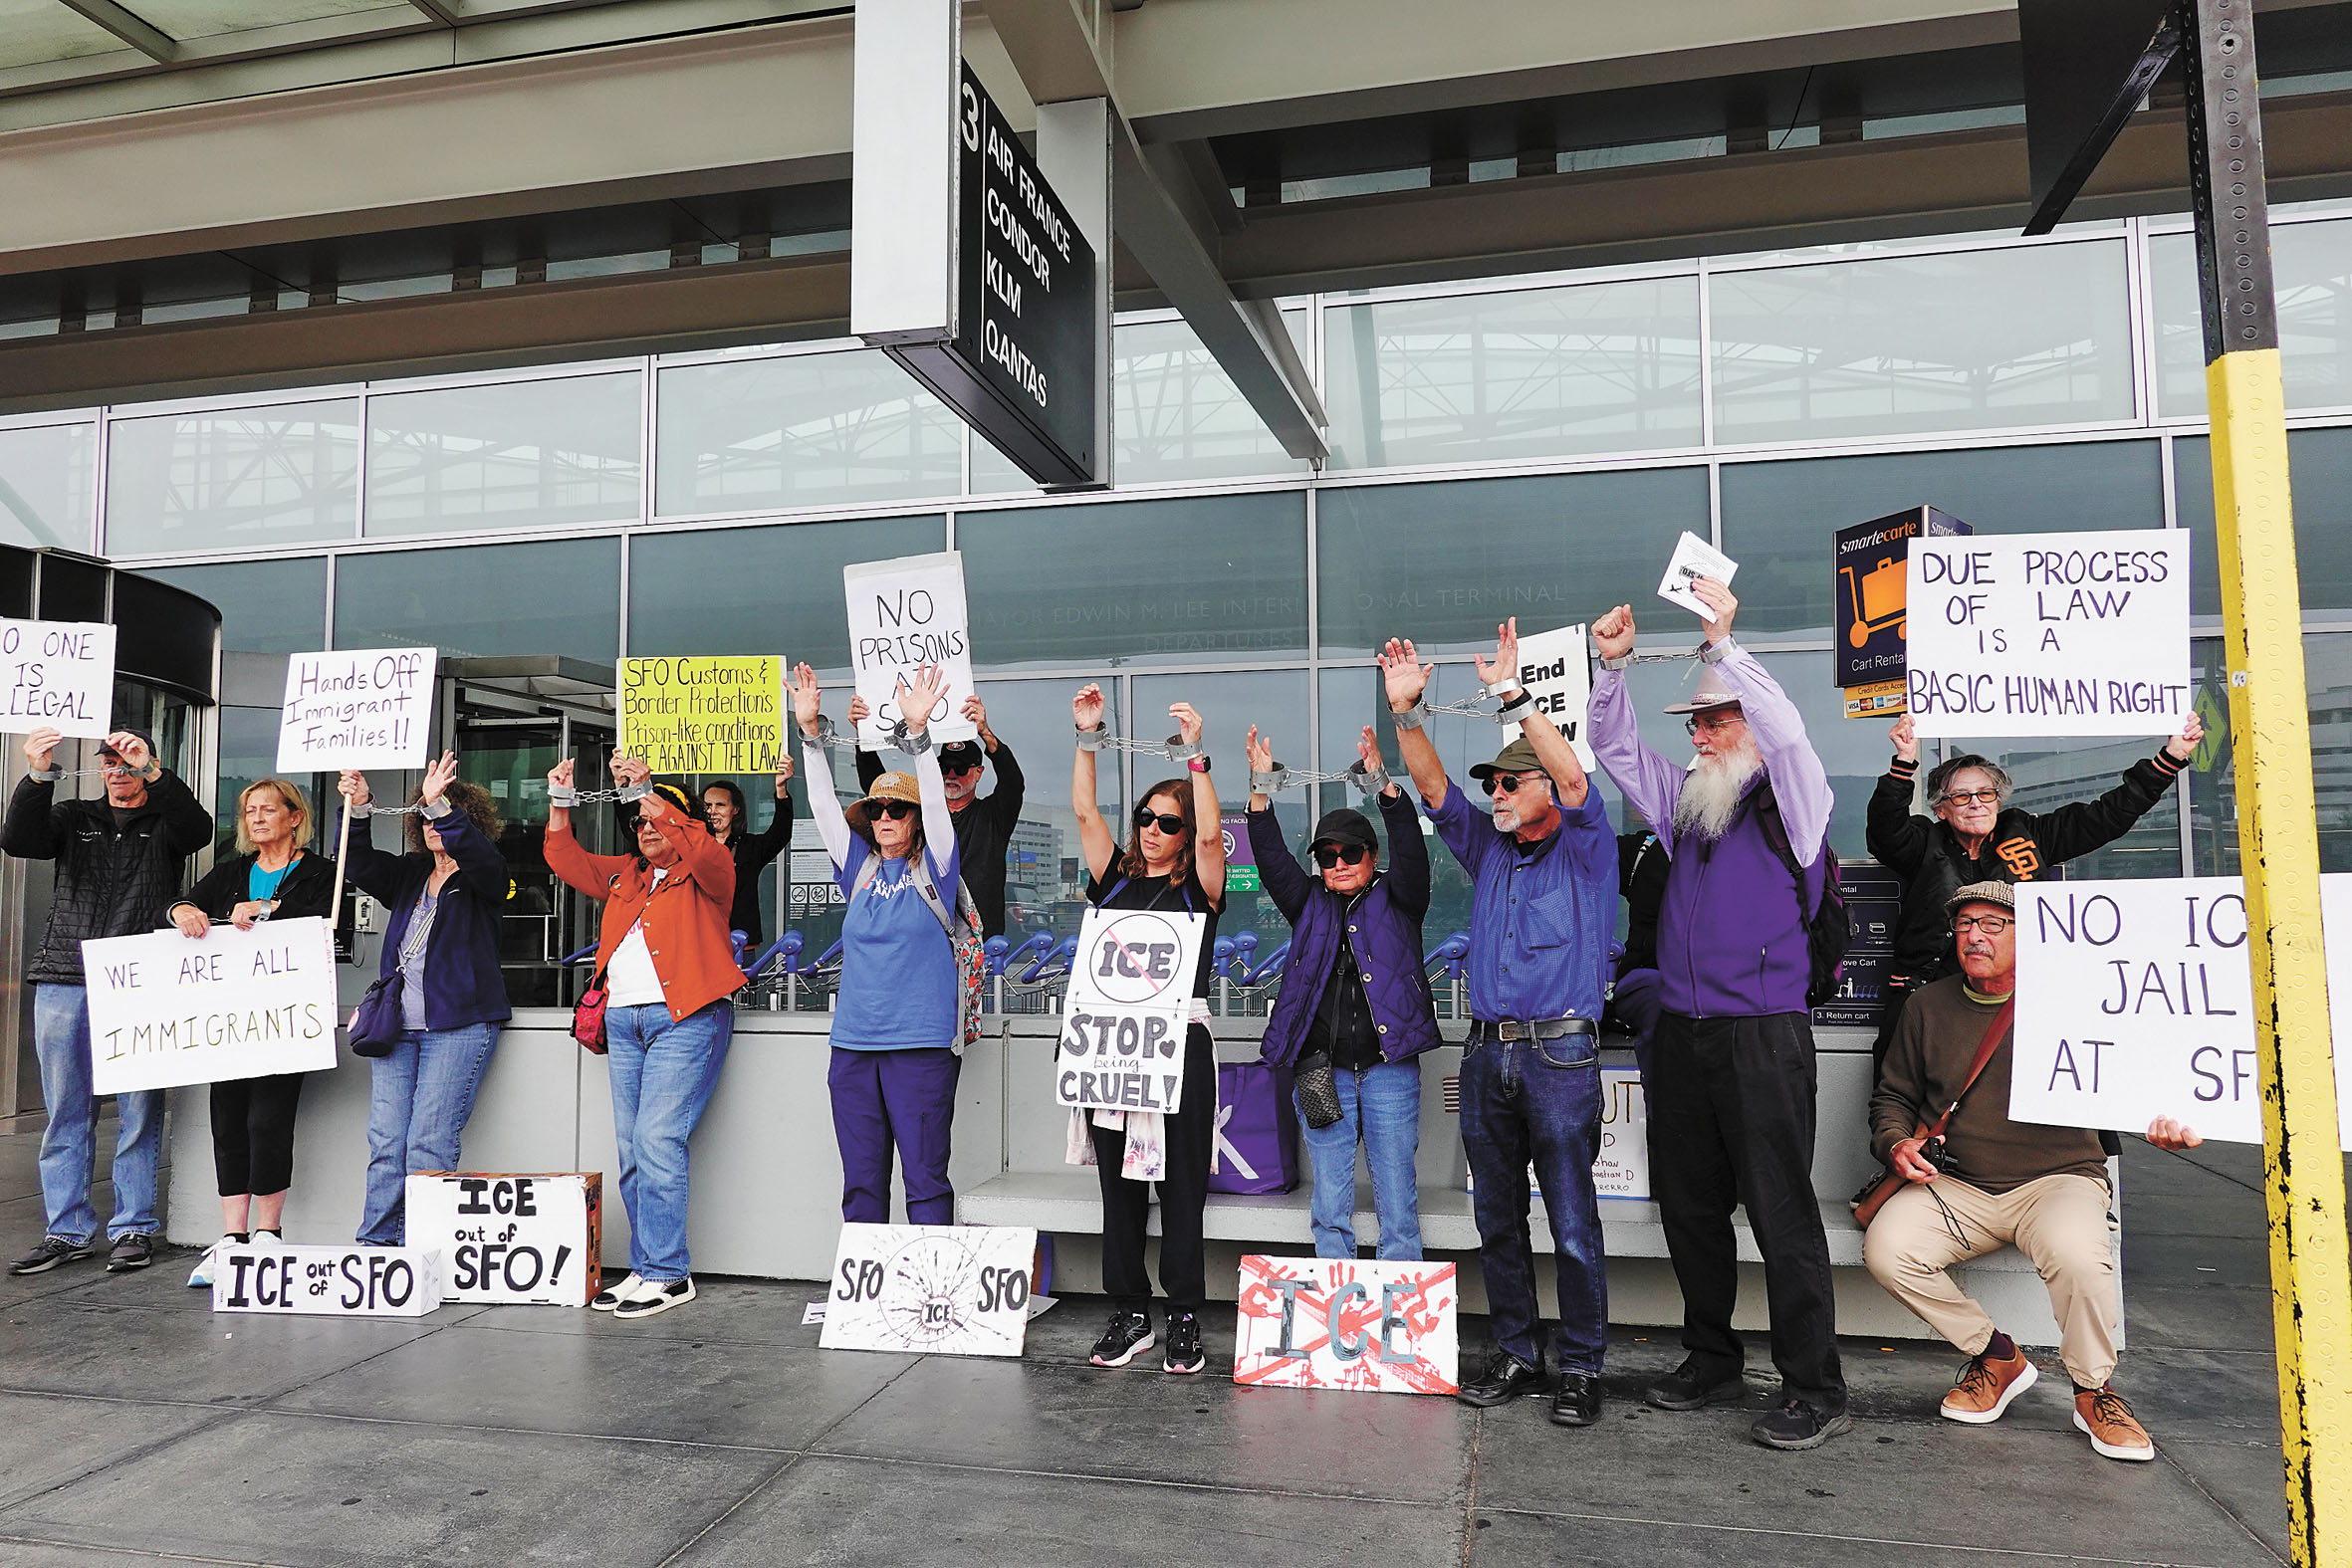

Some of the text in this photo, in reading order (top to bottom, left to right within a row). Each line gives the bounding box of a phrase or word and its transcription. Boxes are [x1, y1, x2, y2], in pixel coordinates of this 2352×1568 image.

[961, 82, 1070, 263] 3 AIR FRANCE
[987, 187, 1051, 293] CONDOR
[987, 249, 1022, 319] KLM
[986, 318, 1048, 408] QANTAS
[1839, 520, 1918, 556] smartecarte
[1922, 550, 2169, 585] DUE PROCESS
[876, 588, 934, 628] NO
[1053, 603, 1131, 625] EDWIN
[1138, 602, 1164, 621] M.
[1173, 598, 1211, 618] LEE
[1436, 584, 1567, 608] TERMINAL
[1946, 588, 2131, 625] OF LAW
[0, 627, 95, 660] O ONE
[859, 630, 964, 670] PRISONS
[1144, 630, 1294, 654] DEPARTURES
[1979, 627, 2061, 654] IS A
[15, 661, 44, 688] IS
[300, 653, 422, 696] Hands Off
[624, 658, 769, 687] SFO Customs &
[1521, 657, 1566, 685] End
[1851, 653, 1904, 672] Cart Renta
[286, 690, 412, 726] Immigrant
[624, 686, 774, 715] Border Protection's
[1534, 692, 1566, 716] CE
[1908, 669, 2188, 716] BASIC HUMAN RIGHT
[625, 715, 776, 744] Prison-like conditions
[876, 696, 949, 732] SO
[658, 743, 715, 772] AGAINST
[723, 742, 745, 772] THE
[750, 742, 782, 772] LAW
[2036, 893, 2248, 949] NO IC
[105, 947, 300, 991] WE ARE ALL
[1098, 941, 1176, 980] ICE
[2101, 959, 2237, 1015] JAIL
[105, 1004, 323, 1061] IMMIGRANTS
[1061, 1012, 1168, 1059] STOP
[1093, 1055, 1145, 1073] being
[2048, 1038, 2257, 1102] AT SF
[1058, 1070, 1178, 1113] CRUEL!
[457, 1178, 538, 1217] ICE
[454, 1223, 518, 1243] out of
[227, 1253, 414, 1310] ICE out of SFO
[837, 1257, 884, 1303] SFO
[977, 1265, 1029, 1313] SFO
[925, 1303, 951, 1323] ICE
[1265, 1278, 1417, 1365] ICE
